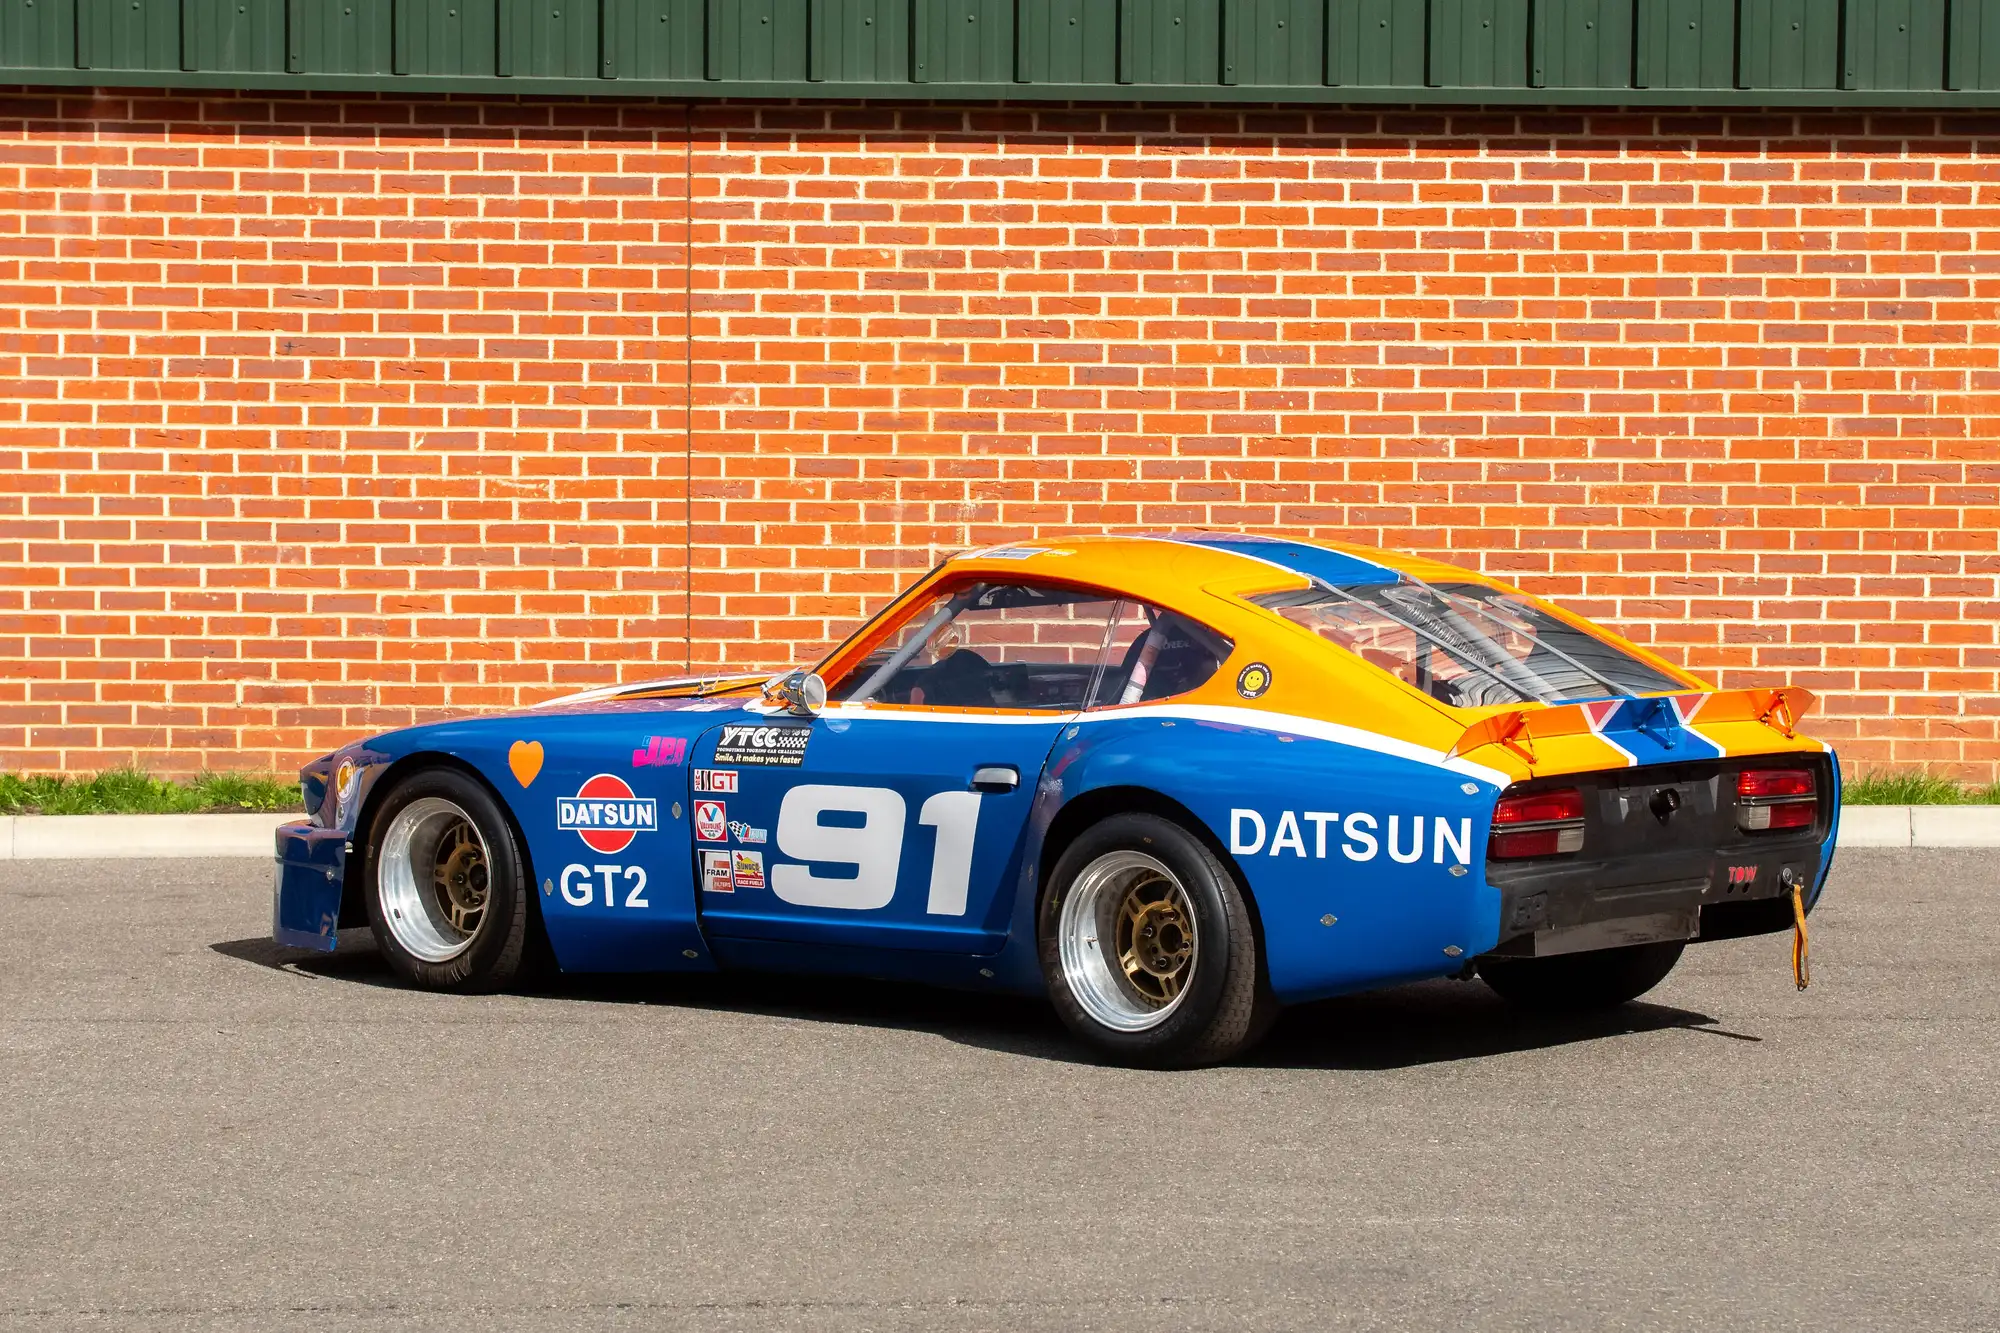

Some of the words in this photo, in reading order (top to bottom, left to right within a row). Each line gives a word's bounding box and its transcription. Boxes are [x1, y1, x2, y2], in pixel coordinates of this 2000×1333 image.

[719, 727, 781, 748] YTCC
[714, 753, 735, 763] Smile,
[735, 753, 742, 762] it
[742, 754, 764, 763] makes
[765, 756, 779, 765] you
[779, 755, 802, 764] faster
[712, 773, 737, 790] GT
[561, 803, 653, 825] DATSUN
[1230, 808, 1472, 865] DATSUN
[771, 784, 982, 916] 91
[706, 869, 728, 877] FRAM
[736, 861, 761, 871] SUNOCO
[1728, 866, 1758, 883] TOW
[560, 863, 649, 907] GT2
